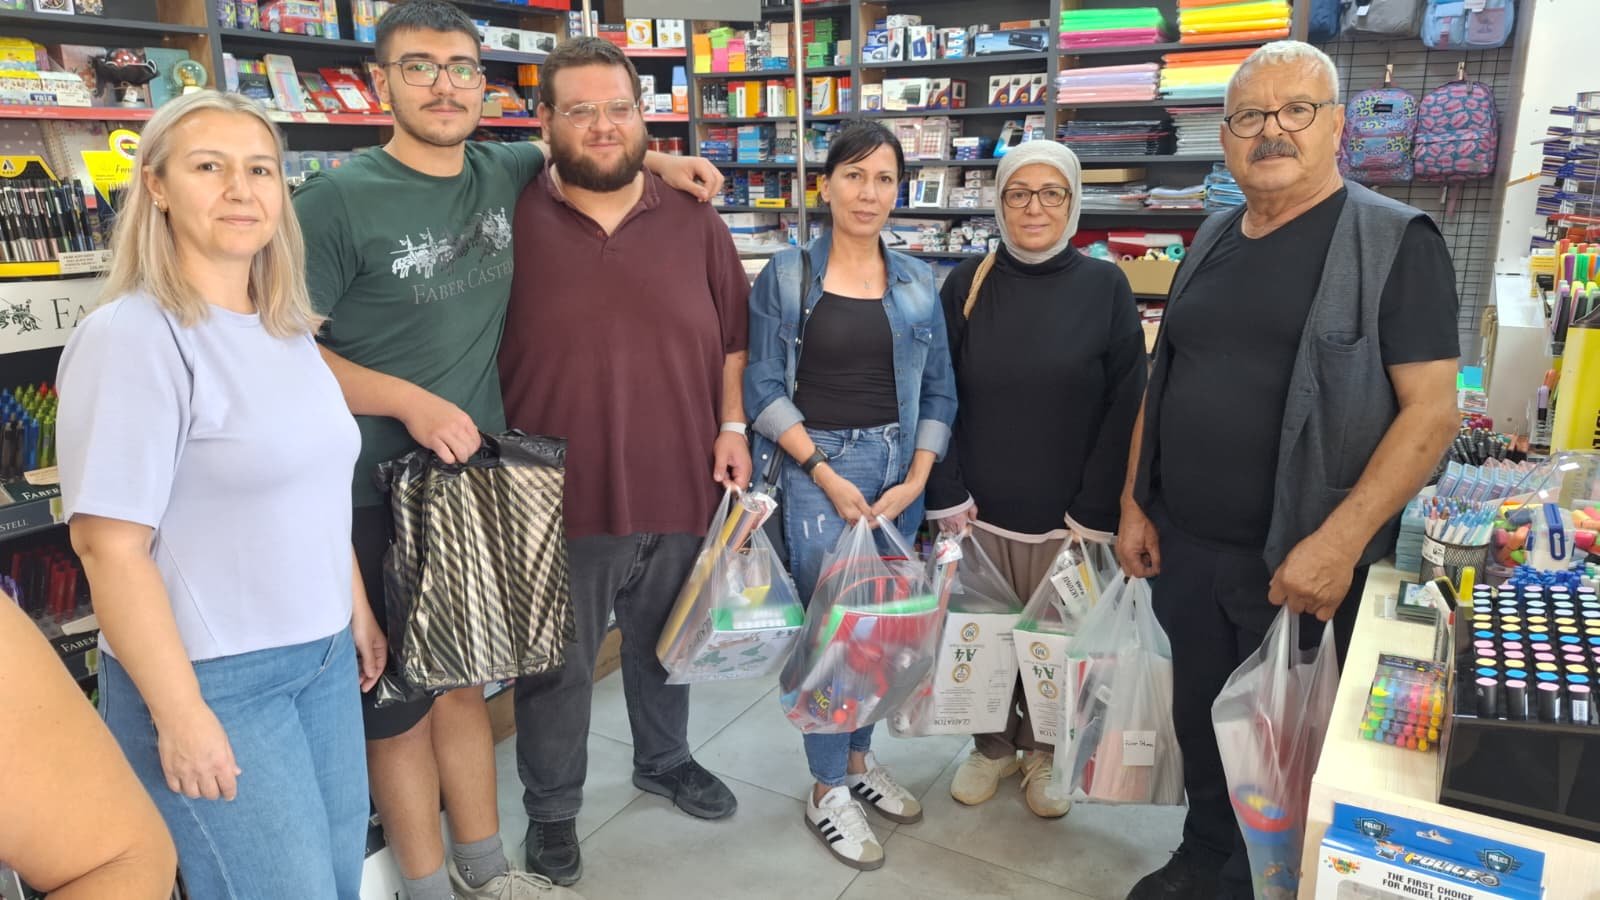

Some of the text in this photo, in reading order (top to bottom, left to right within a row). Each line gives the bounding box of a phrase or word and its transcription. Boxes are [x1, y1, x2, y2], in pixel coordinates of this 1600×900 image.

[953, 648, 977, 662] A4
[1032, 665, 1055, 680] A4
[1488, 853, 1509, 865] POLICE
[1382, 878, 1401, 890] FOR
[1403, 884, 1433, 900] MODEL
[1387, 871, 1474, 900] THE FIRST CHOICE
